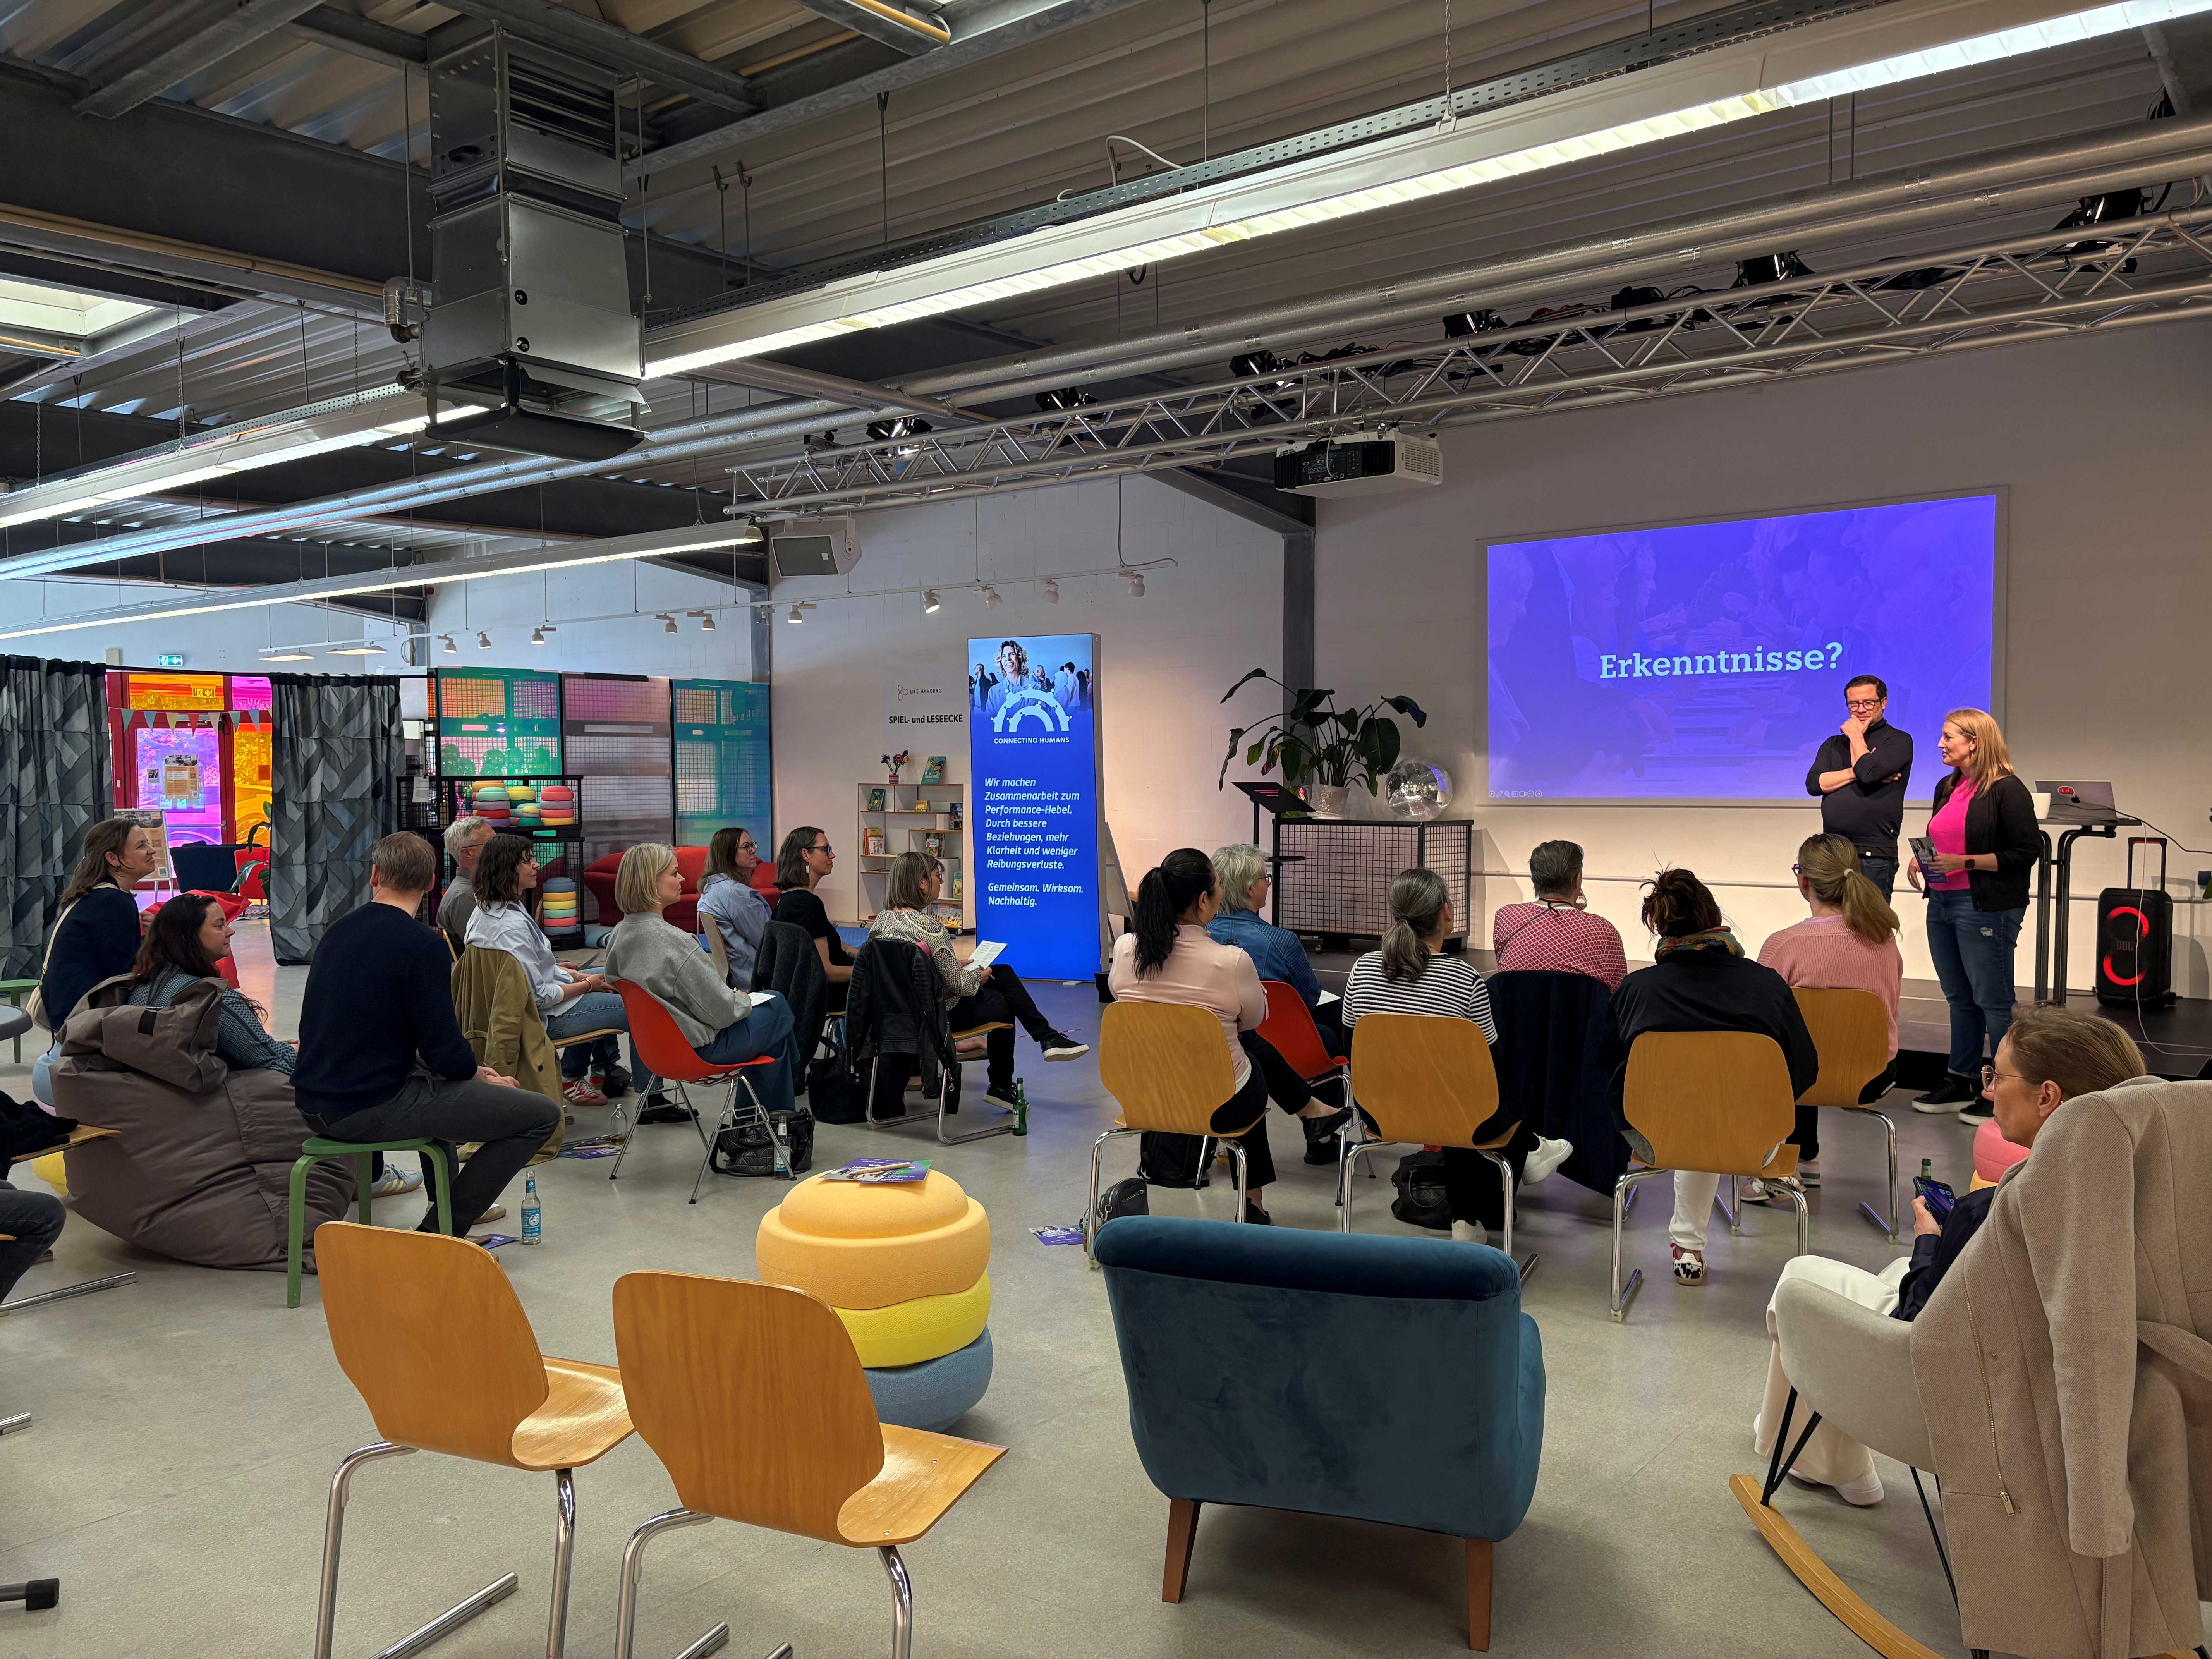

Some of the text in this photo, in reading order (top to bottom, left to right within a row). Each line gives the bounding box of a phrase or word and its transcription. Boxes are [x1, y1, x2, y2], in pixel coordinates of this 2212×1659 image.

[1600, 642, 1843, 678] Erkenntnisse?
[912, 715, 925, 723] und
[927, 714, 963, 723] LESEECKE
[985, 777, 1036, 787] Wir machen
[984, 791, 1059, 800] Zusammenarbeit
[985, 805, 1072, 816] Performance-Hebel.
[986, 818, 1047, 828] Durch bessere
[986, 832, 1070, 843] Beziehungen, mehr
[987, 845, 1078, 857] Klarheit und weniger
[987, 859, 1064, 870] Reibungsverluste.
[988, 882, 1084, 893] Gemeinsam. Wirksam.
[988, 896, 1037, 908] Nachhaltig.
